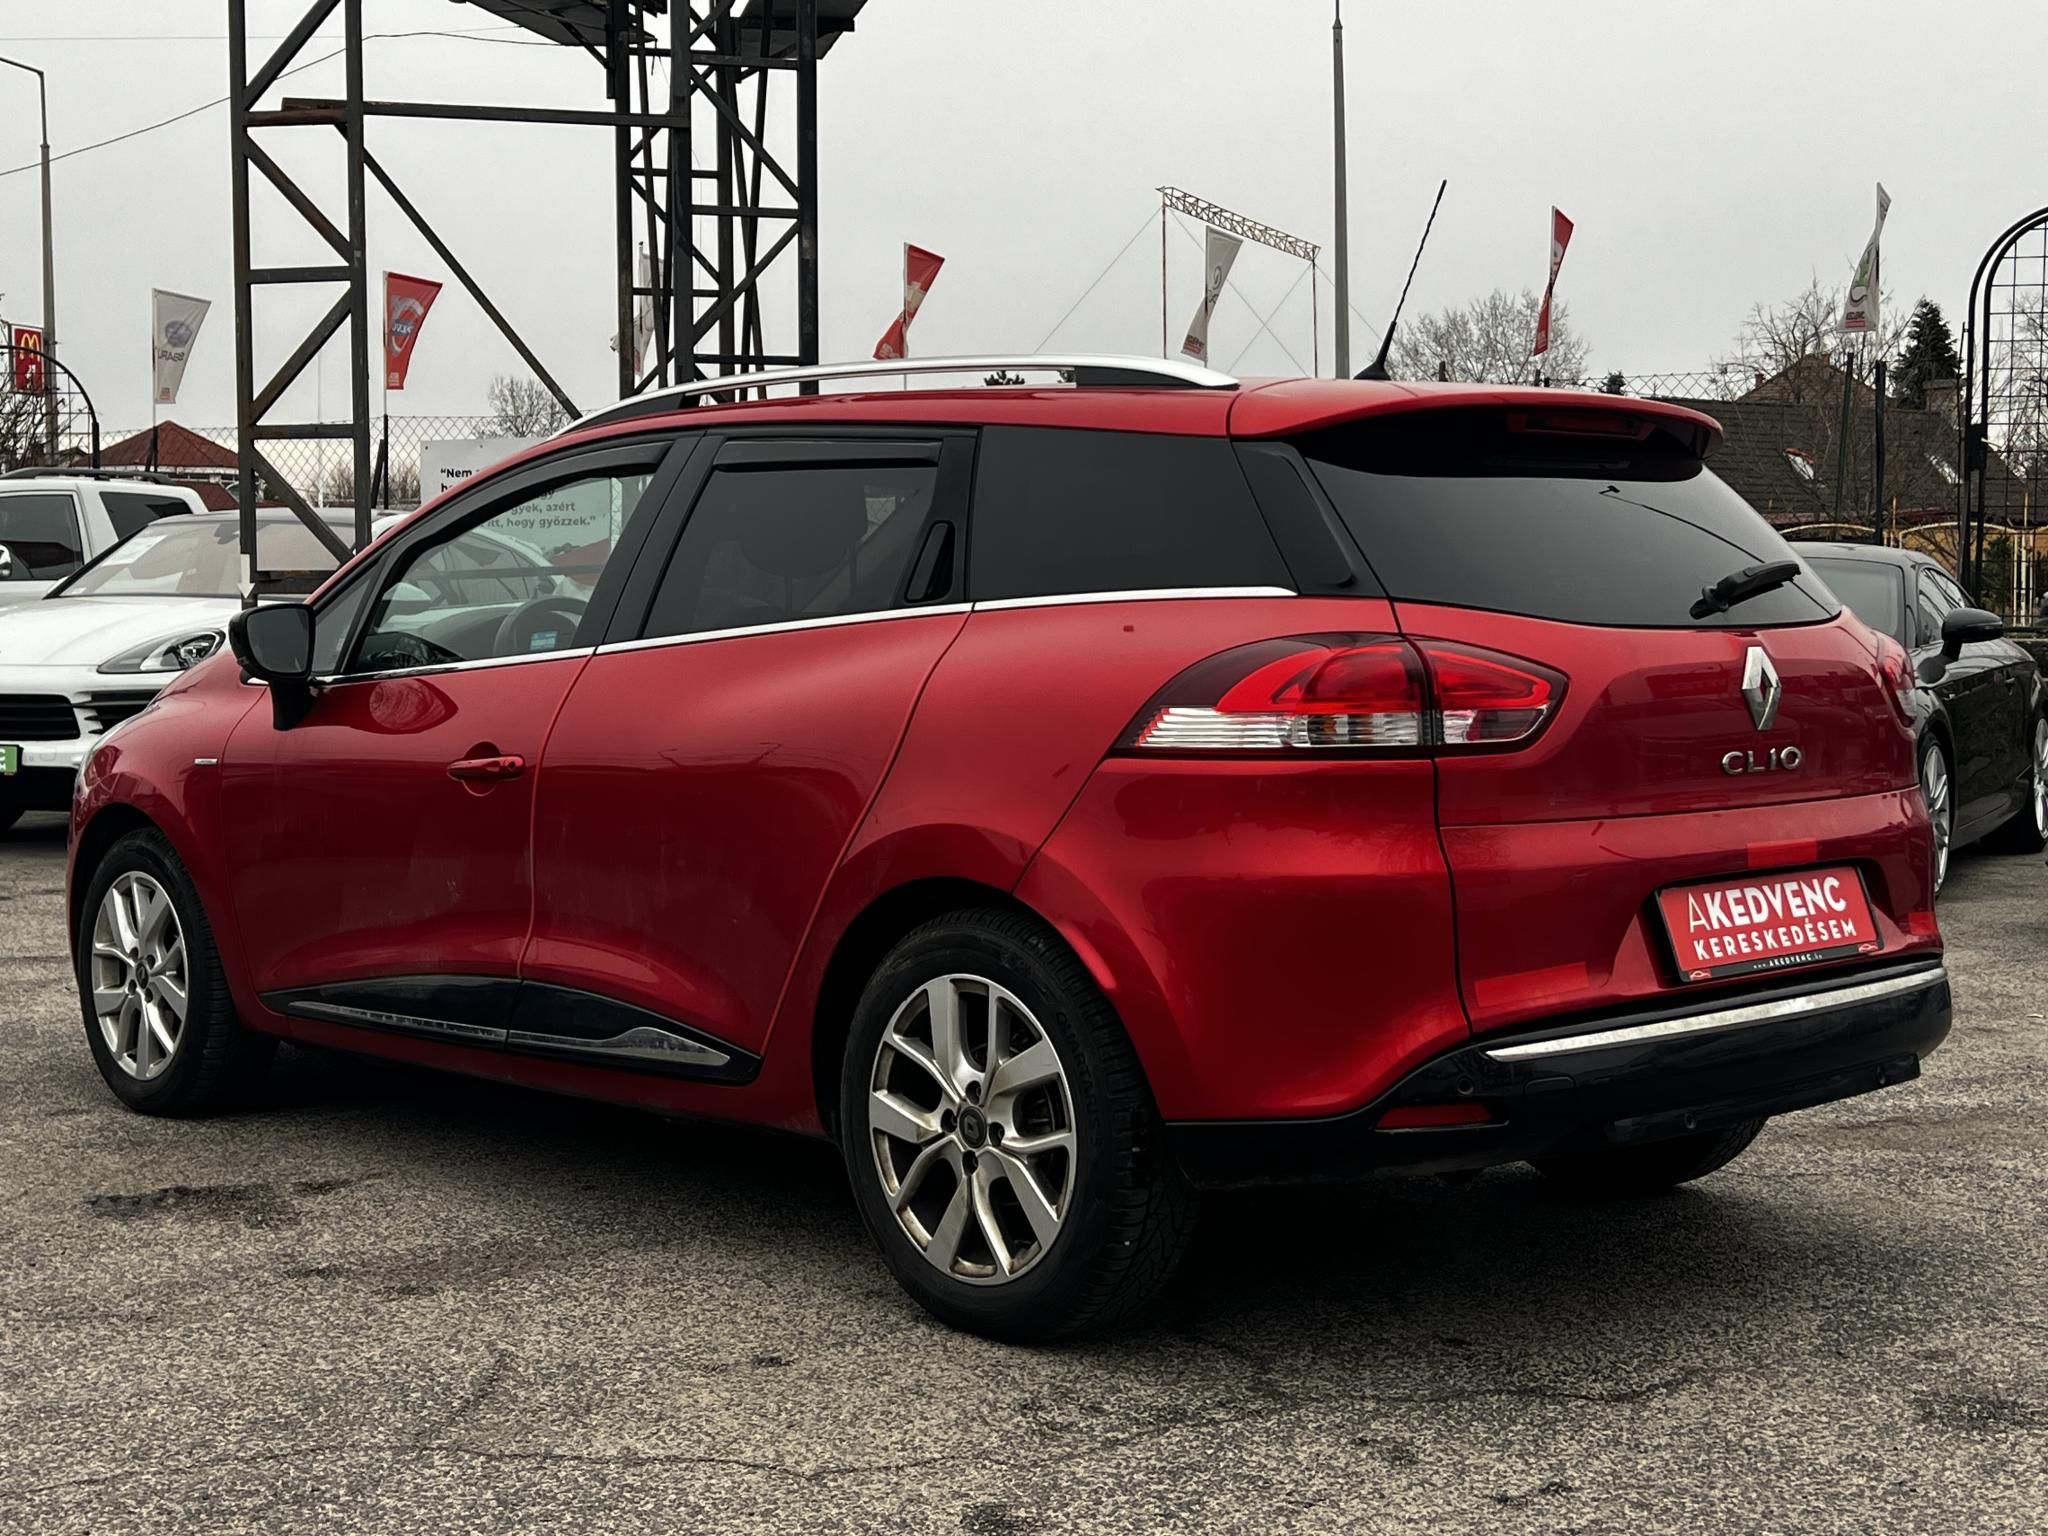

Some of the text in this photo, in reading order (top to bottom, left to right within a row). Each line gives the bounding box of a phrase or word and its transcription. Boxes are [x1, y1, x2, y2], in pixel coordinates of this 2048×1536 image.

[546, 501, 576, 512] azért
[507, 517, 535, 528] hogy
[1722, 746, 1802, 775] CLIO
[1693, 918, 1857, 961] KERESKEDÉSEM
